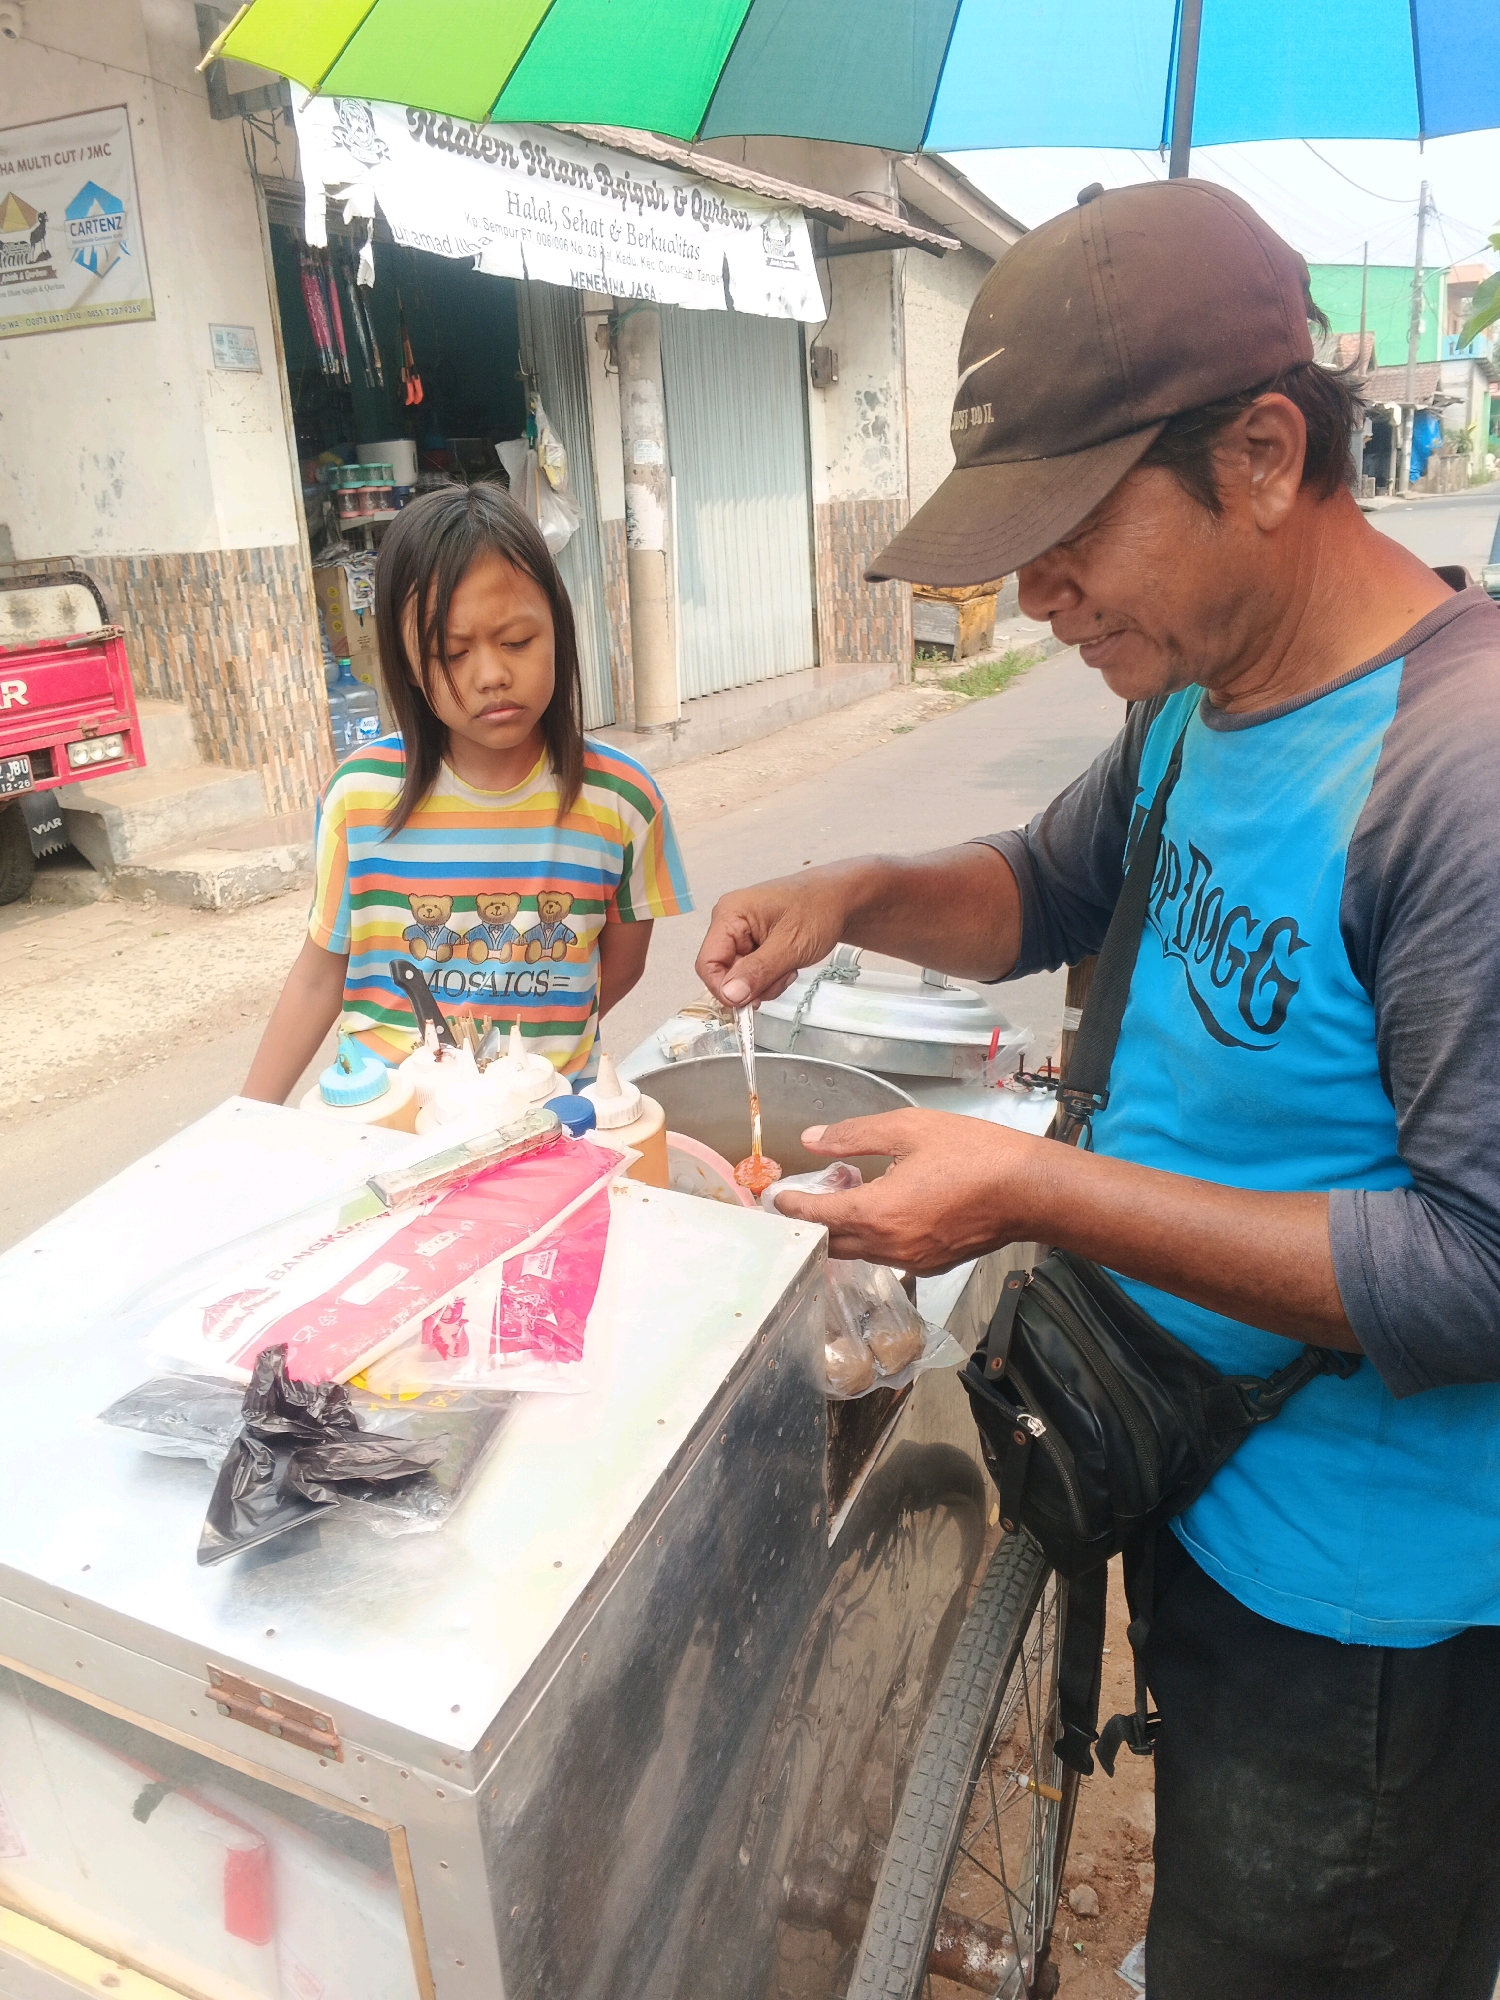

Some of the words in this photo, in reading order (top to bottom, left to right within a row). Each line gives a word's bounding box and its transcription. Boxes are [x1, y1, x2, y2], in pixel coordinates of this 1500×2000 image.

[17, 155, 51, 172] MULTI
[54, 149, 76, 165] CUT
[88, 143, 112, 160] JMC
[520, 139, 593, 190] Ilham
[673, 186, 687, 217] &
[691, 187, 752, 232] Qurban
[70, 216, 123, 237] CARTENZ
[482, 217, 518, 240] Sempur
[505, 190, 558, 231] Halal,
[561, 206, 604, 238] Sehat
[609, 219, 622, 242] &
[626, 222, 700, 260] Berkualitas
[951, 409, 968, 431] JUST
[970, 405, 982, 425] DO
[6, 758, 29, 782] JBU
[32, 817, 62, 835] VIAR
